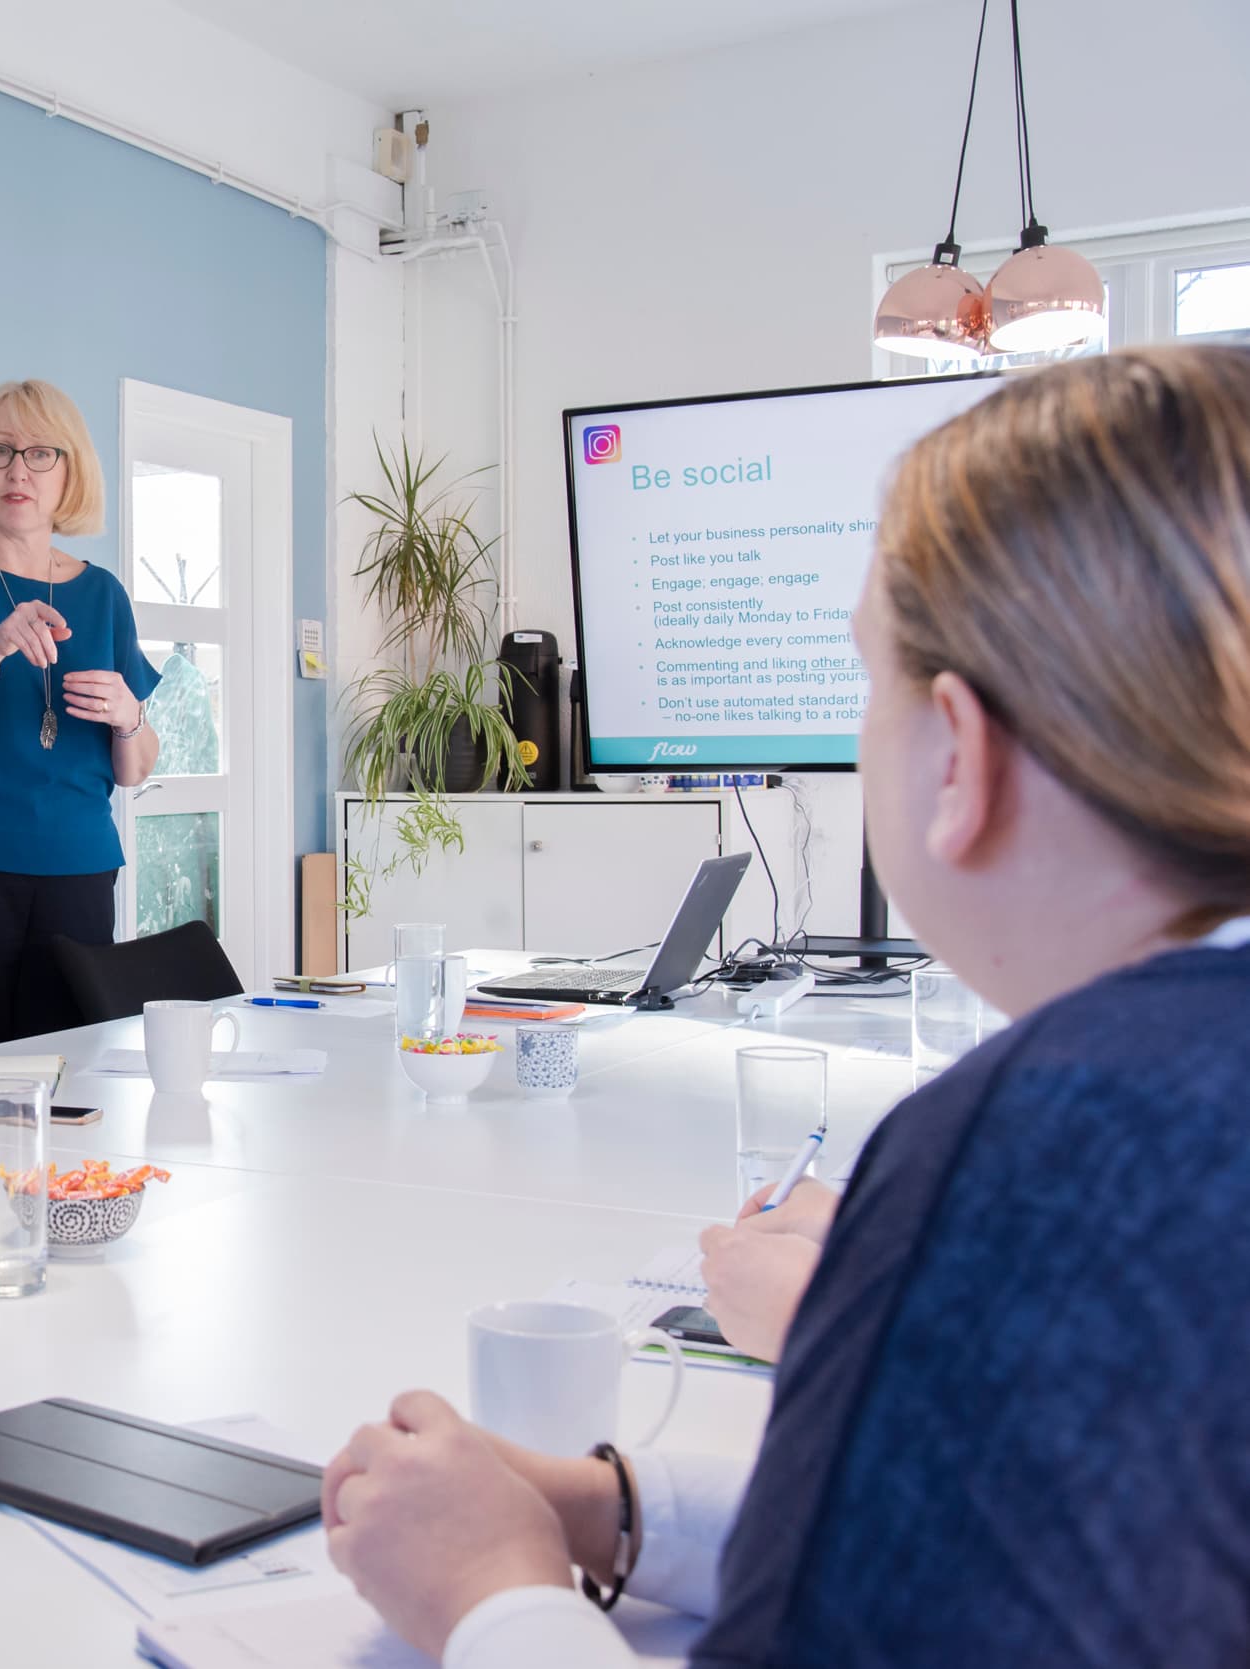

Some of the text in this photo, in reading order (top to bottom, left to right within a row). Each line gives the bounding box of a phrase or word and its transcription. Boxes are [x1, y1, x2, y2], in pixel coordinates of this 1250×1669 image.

[632, 454, 772, 491] Be social
[649, 519, 878, 546] Let your business personality shin
[650, 549, 762, 567] Post like you talk
[768, 572, 820, 587] engage
[653, 597, 764, 613] Post consistently
[654, 613, 700, 629] (ideally
[704, 612, 734, 627] daily
[738, 610, 792, 625] Monday
[796, 609, 809, 622] to
[655, 636, 742, 650] Acknowledge
[746, 636, 783, 649] every
[656, 659, 739, 673] Commenting
[743, 658, 768, 670] and
[772, 657, 807, 672] liking
[811, 656, 846, 669] other
[657, 674, 669, 686] is
[671, 675, 687, 686] as
[691, 673, 753, 688] important
[756, 673, 772, 684] as
[776, 671, 826, 686] posting
[658, 696, 693, 709] Don't
[696, 698, 719, 708] use
[723, 695, 794, 708] automated
[798, 692, 858, 706] standard
[675, 711, 720, 722] no-one
[724, 708, 754, 721] likes
[758, 708, 802, 723] talking
[805, 708, 818, 720] to
[822, 709, 831, 720] a
[835, 706, 865, 720] robo
[647, 741, 698, 762] flow
